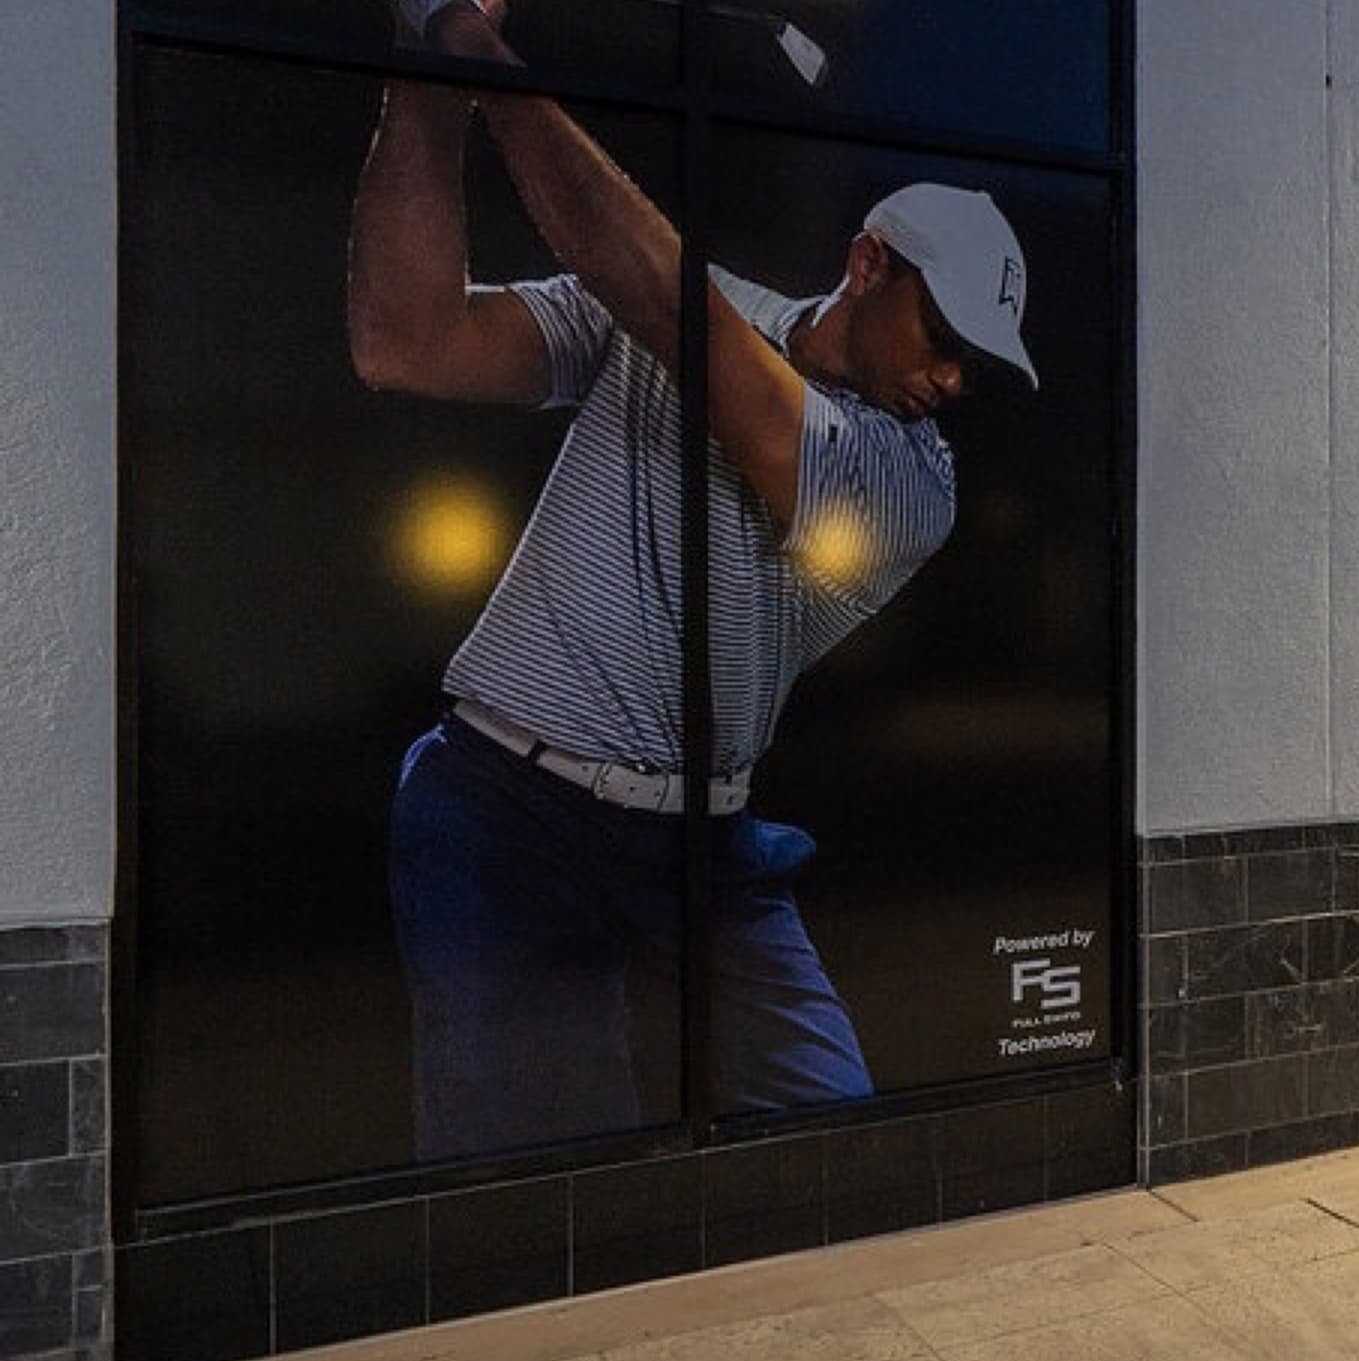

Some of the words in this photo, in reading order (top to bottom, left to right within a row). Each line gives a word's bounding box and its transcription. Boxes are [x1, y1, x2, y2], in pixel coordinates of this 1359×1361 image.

[994, 931, 1070, 954] Powered
[1073, 928, 1096, 949] by
[998, 1029, 1096, 1057] Technology
